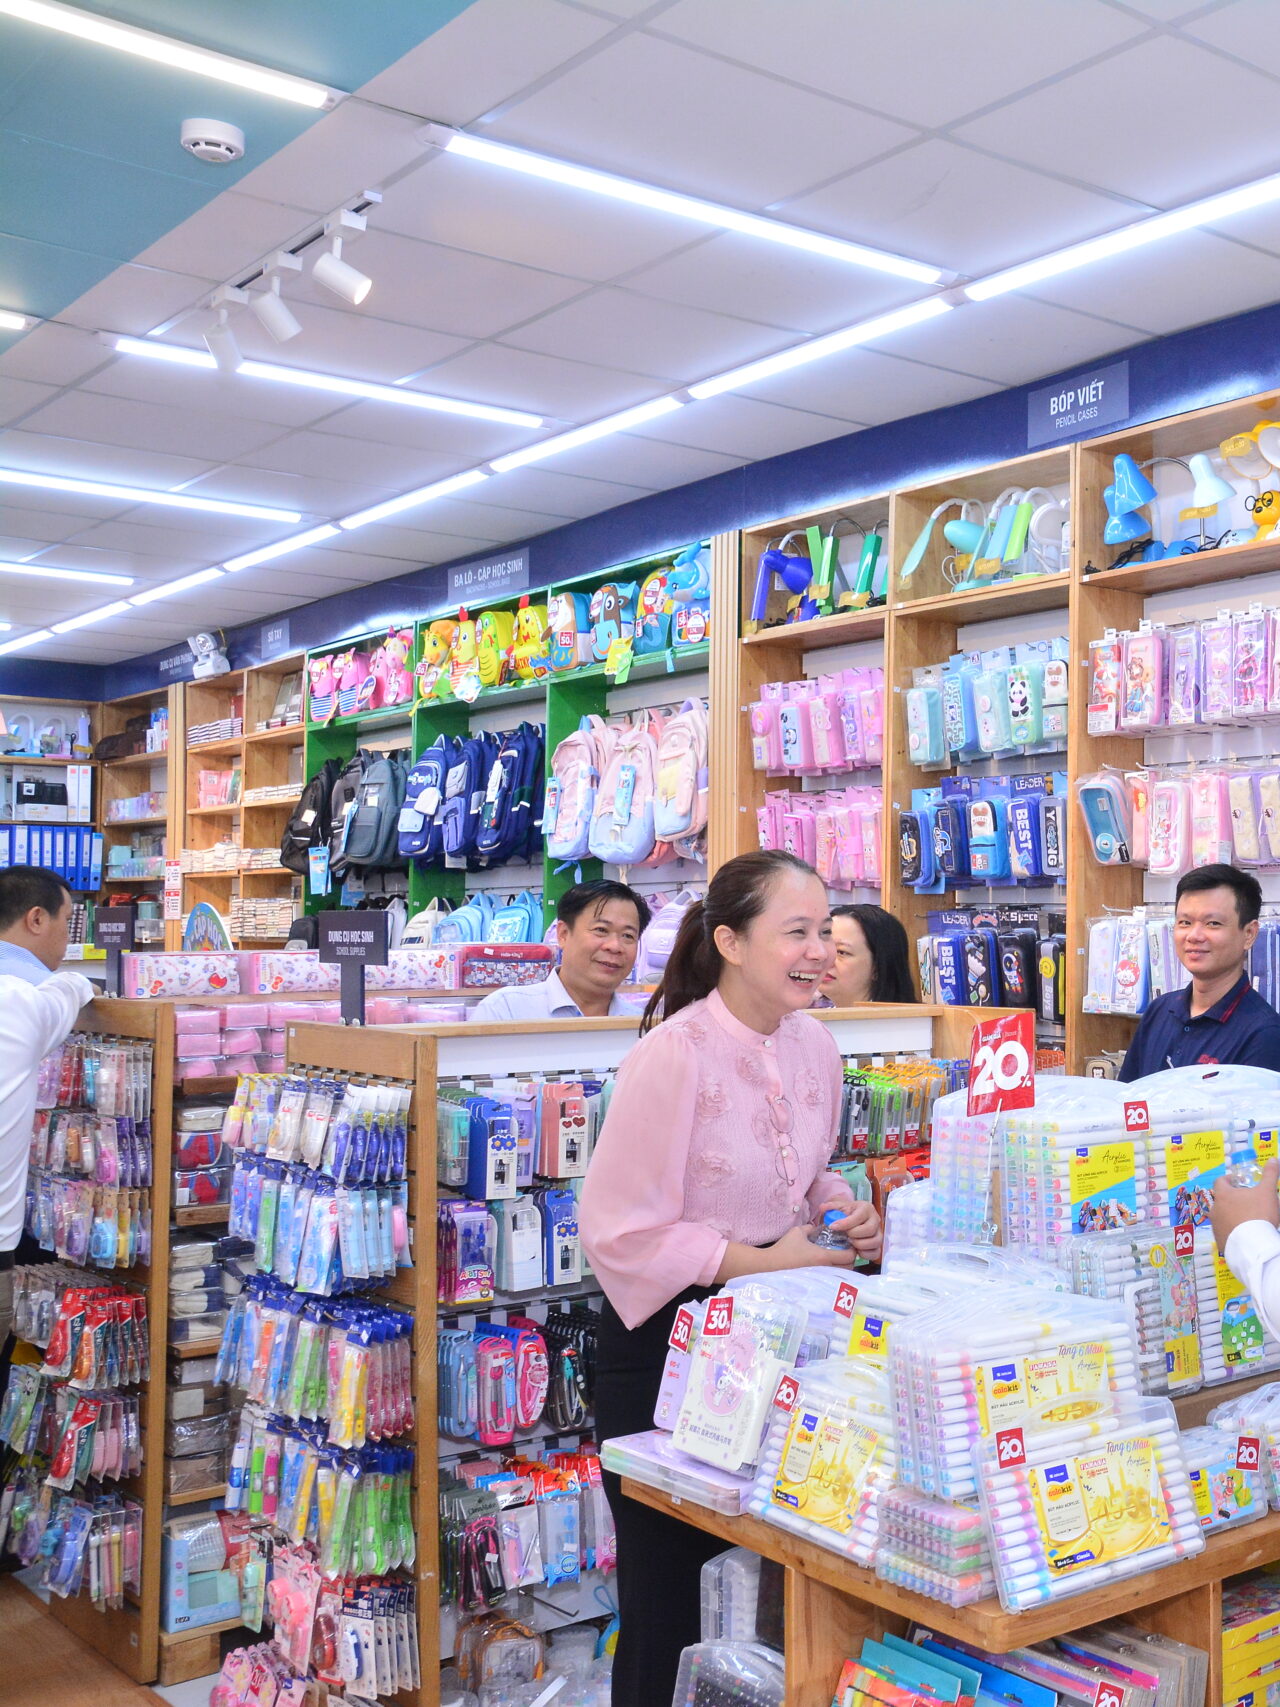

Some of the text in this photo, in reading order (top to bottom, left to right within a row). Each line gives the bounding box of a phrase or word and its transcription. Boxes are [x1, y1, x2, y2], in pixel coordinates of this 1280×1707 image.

[1050, 378, 1105, 416] BÓP VIẾT
[1055, 406, 1098, 429] PENCIL CASES
[454, 574, 464, 588] BA
[464, 569, 473, 585] LÔ
[477, 566, 491, 581] CẶP
[492, 562, 506, 578] HỌC
[507, 557, 523, 574] SINH
[1015, 776, 1044, 790] LEADER
[1015, 808, 1032, 850] BEST
[942, 913, 969, 926] LEADER
[1010, 910, 1039, 924] Space
[328, 930, 374, 944] DỤNG CỤ HỌC SINH
[940, 945, 956, 985] BEST
[1194, 1137, 1217, 1152] Acrylic
[1102, 1149, 1127, 1165] Acrylic
[1058, 1344, 1077, 1360] Tặng
[1085, 1343, 1104, 1355] Màu
[993, 1384, 1019, 1395] colokit
[999, 1438, 1025, 1462] 20%
[1106, 1441, 1125, 1456] Tặng
[1131, 1439, 1150, 1451] Màu
[1048, 1485, 1073, 1497] colokit
